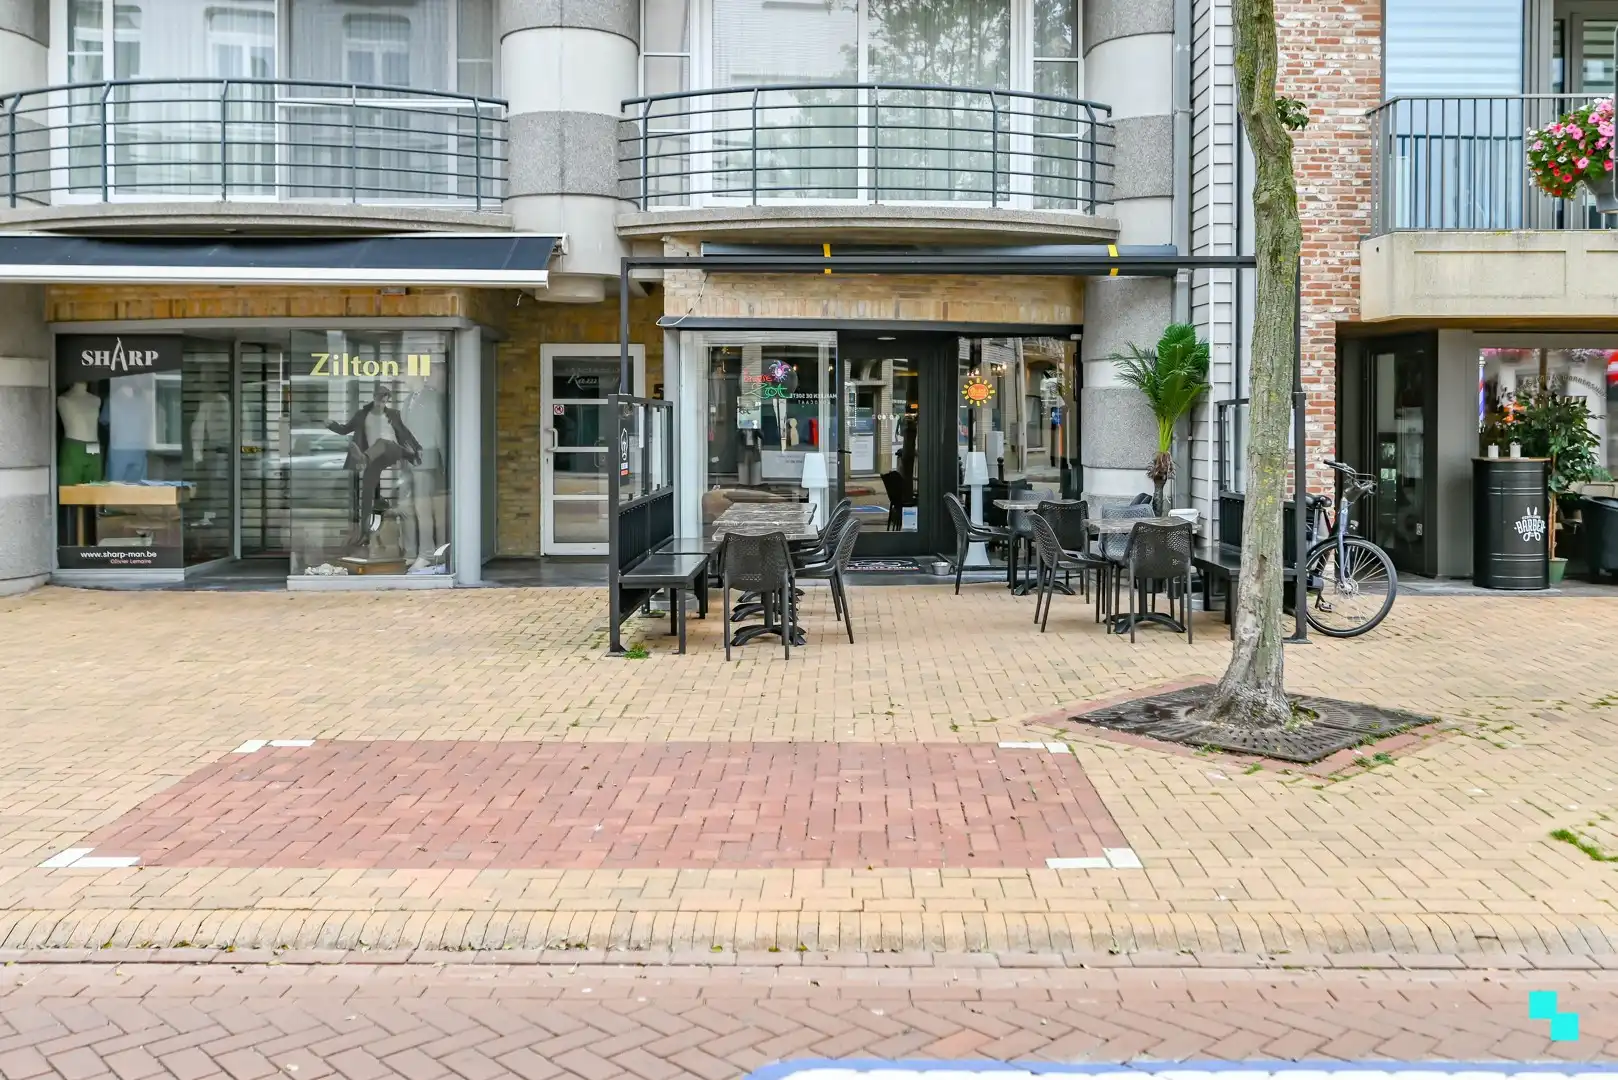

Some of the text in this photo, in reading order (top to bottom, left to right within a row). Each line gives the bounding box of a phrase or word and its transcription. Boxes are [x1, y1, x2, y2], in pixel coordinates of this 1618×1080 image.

[81, 337, 159, 371] SHARP
[310, 353, 399, 376] Zilton
[1515, 519, 1545, 534] BARBER
